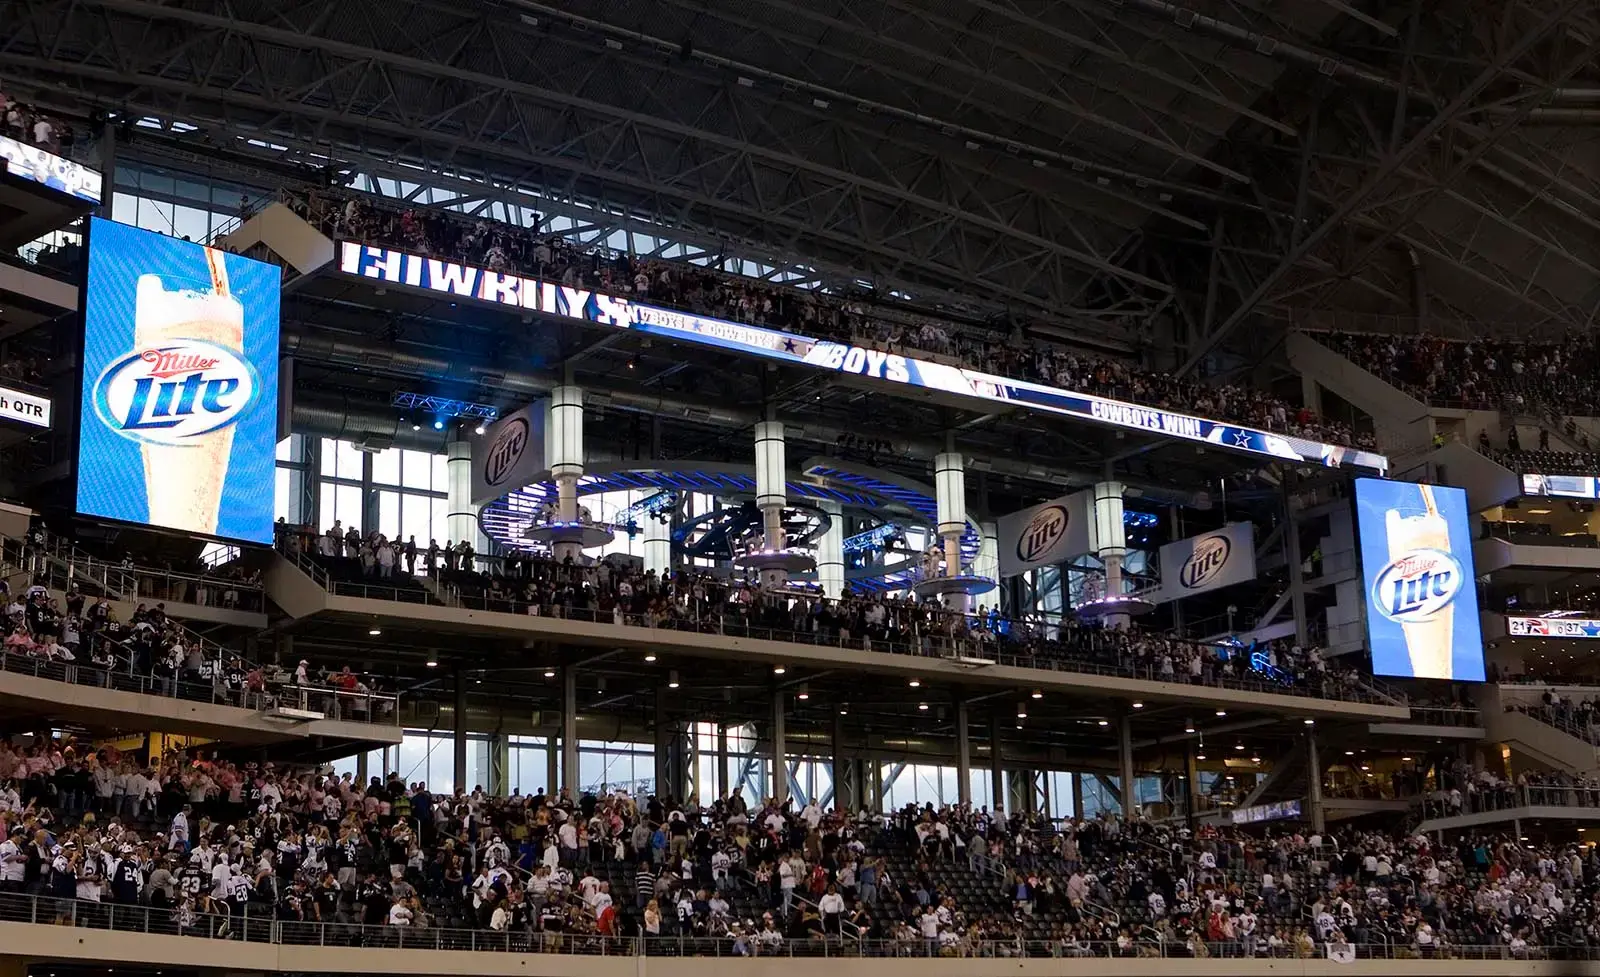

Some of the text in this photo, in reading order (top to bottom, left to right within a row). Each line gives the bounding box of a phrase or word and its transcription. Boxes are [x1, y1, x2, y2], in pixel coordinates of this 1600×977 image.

[141, 350, 220, 374] Miller
[13, 400, 43, 417] QTR
[120, 372, 239, 429] Lite
[1091, 401, 1201, 437] COWBOYS WIN!
[492, 432, 522, 483] Lite
[1027, 516, 1061, 559] Lite
[1190, 546, 1223, 586] Lite
[1390, 570, 1450, 616] Lite
[1512, 621, 1525, 630] 21
[1566, 623, 1579, 632] 37
[124, 866, 138, 881] 24
[181, 877, 201, 894] 23
[235, 886, 248, 902] 28
